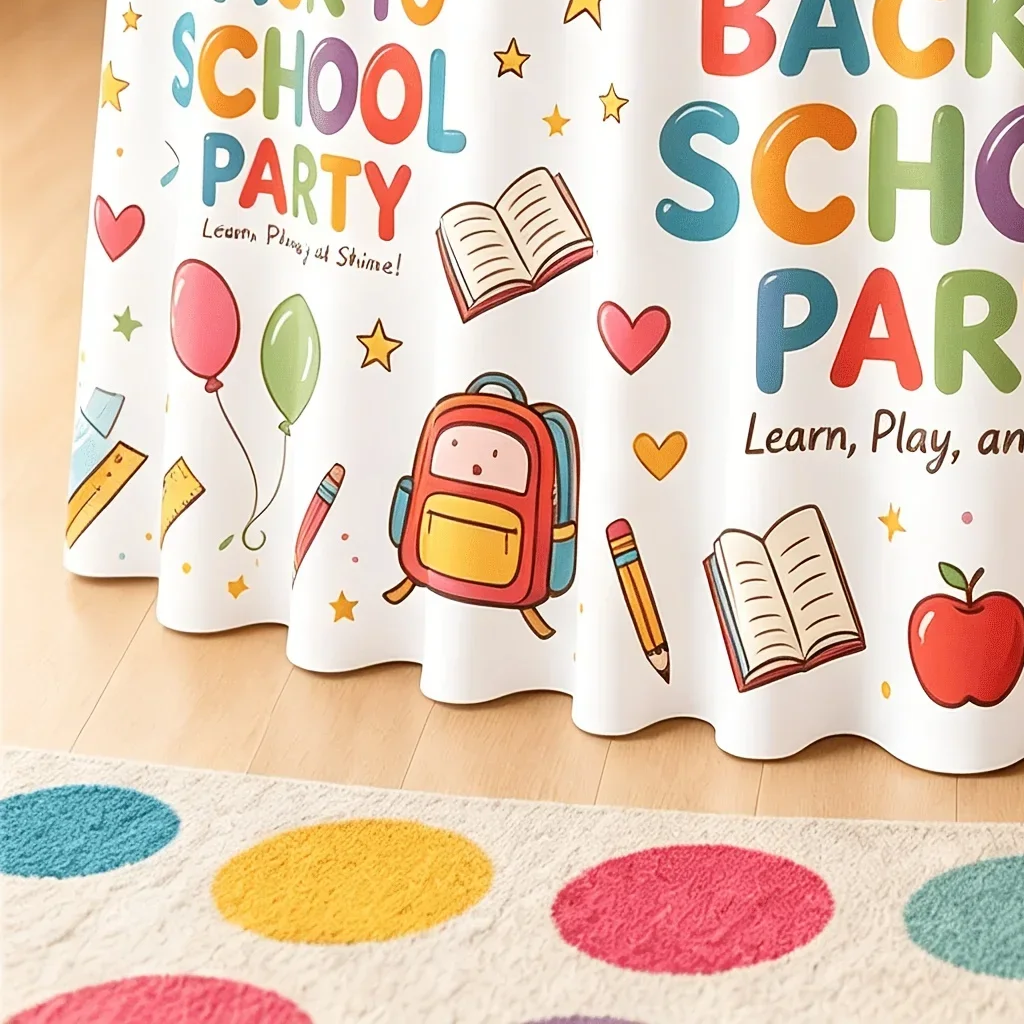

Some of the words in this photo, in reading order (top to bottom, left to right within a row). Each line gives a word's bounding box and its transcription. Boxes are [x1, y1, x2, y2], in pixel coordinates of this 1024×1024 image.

[172, 11, 467, 153] SCHOOL
[202, 132, 411, 241] PARTY
[744, 411, 857, 458] Learn,
[871, 408, 961, 474] Play,
